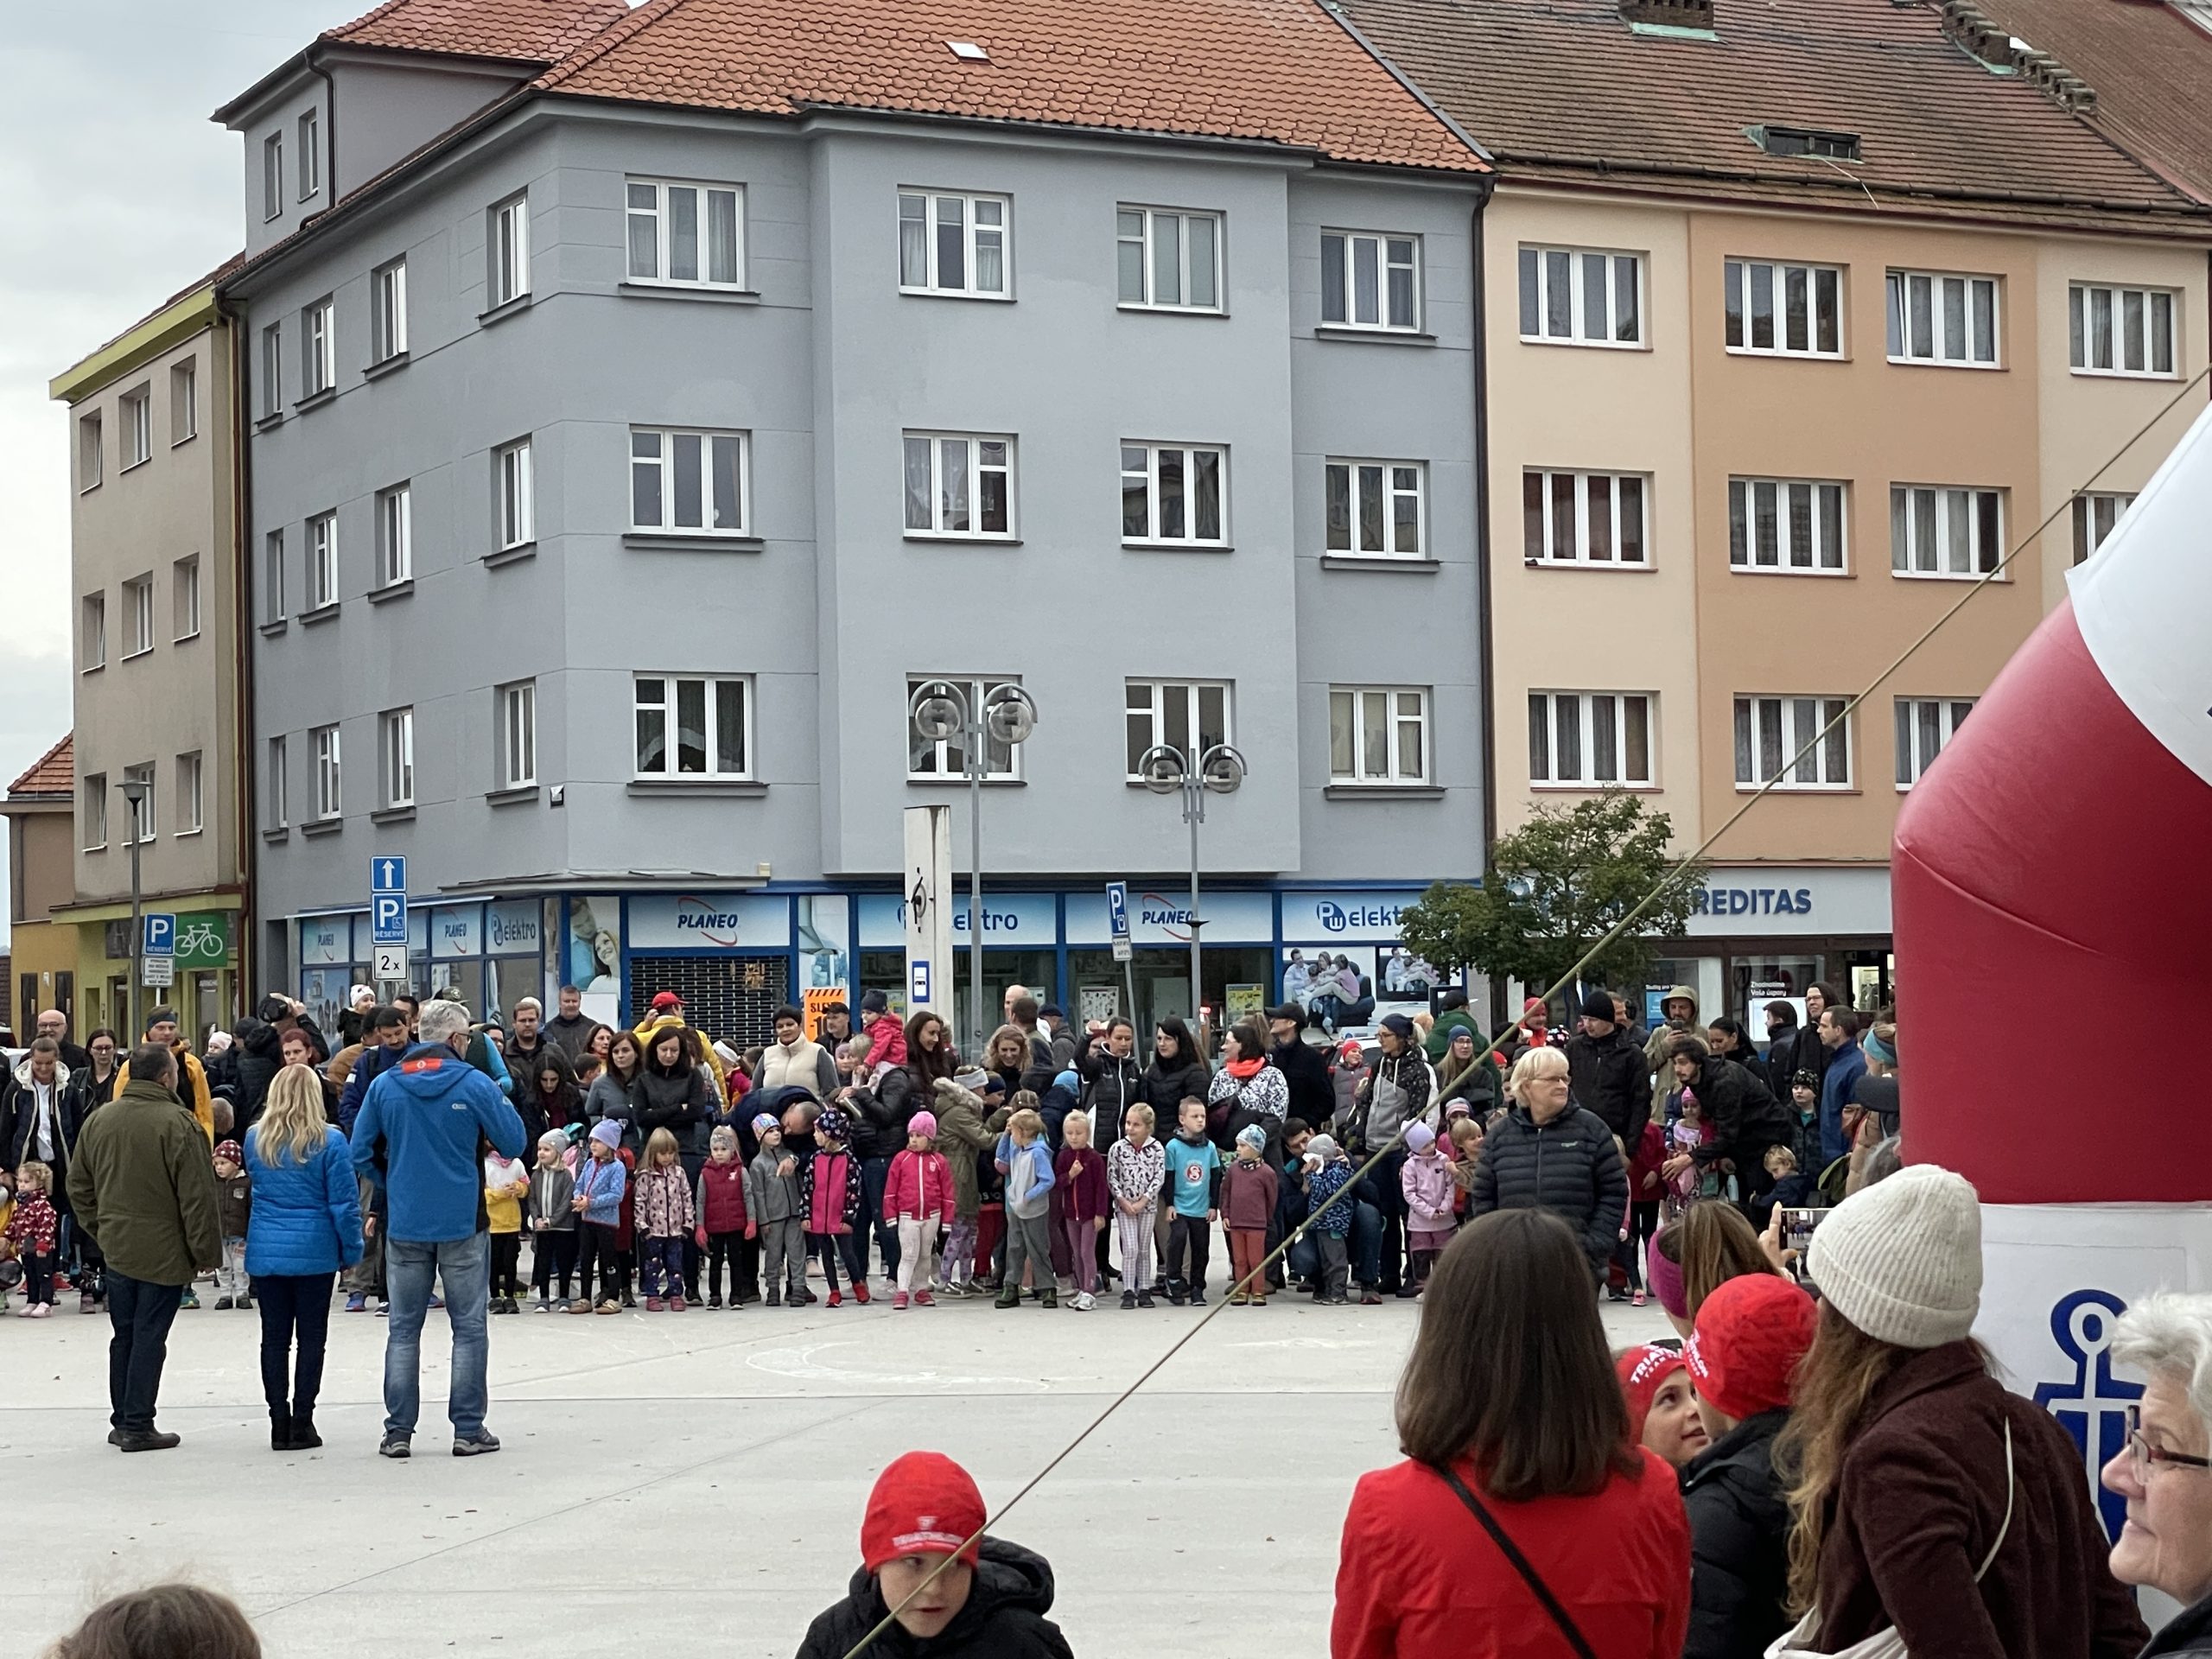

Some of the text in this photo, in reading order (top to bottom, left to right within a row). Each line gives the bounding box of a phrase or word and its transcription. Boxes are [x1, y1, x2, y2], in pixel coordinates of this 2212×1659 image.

[379, 899, 399, 928] P
[1110, 889, 1122, 918] P
[1692, 888, 1812, 915] REDITAS
[677, 914, 738, 929] PLANEO
[1349, 906, 1403, 927] elekt
[151, 918, 169, 944] P
[504, 918, 536, 941] elektro
[381, 955, 400, 970] 2 x
